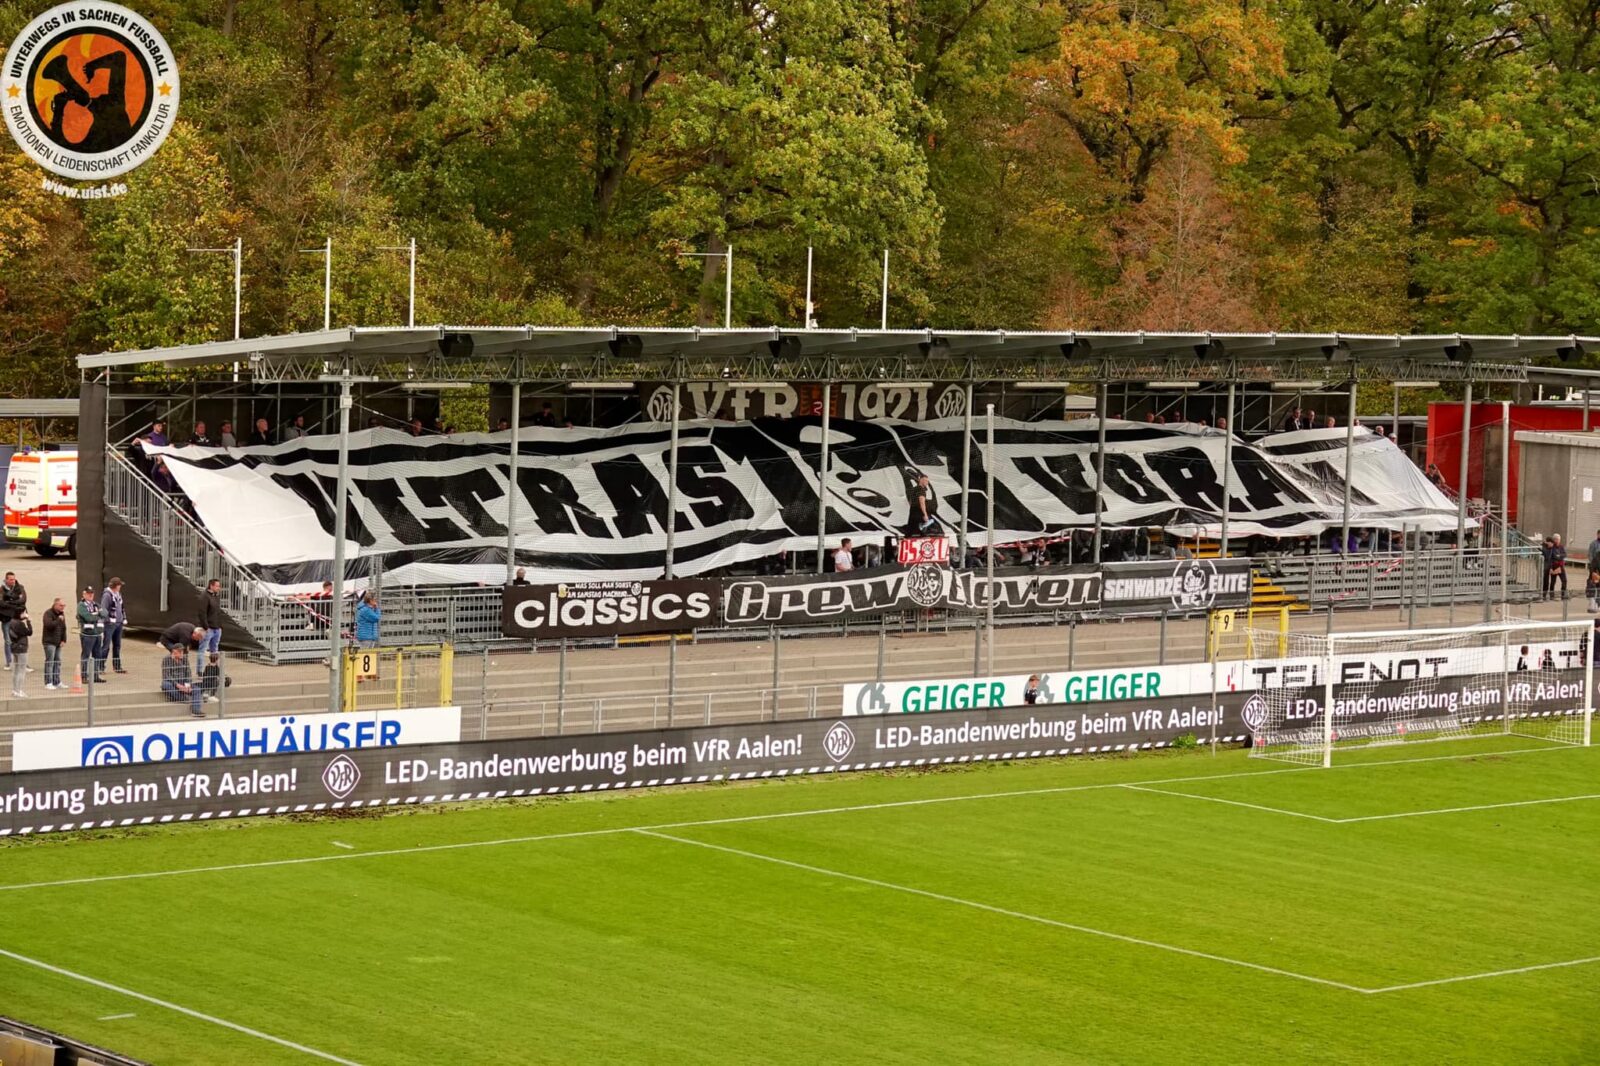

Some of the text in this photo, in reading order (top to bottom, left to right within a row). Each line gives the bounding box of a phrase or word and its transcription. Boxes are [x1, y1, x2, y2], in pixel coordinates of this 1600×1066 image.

[687, 382, 929, 422] VfR 1921
[724, 577, 904, 623] Crew
[1104, 573, 1248, 600] SCHWARZE ELITE
[514, 587, 711, 629] classics
[1223, 614, 1230, 630] 9
[363, 654, 370, 672] 8
[902, 682, 1005, 713] GEIGER
[1065, 672, 1161, 703] GEIGER
[1286, 689, 1458, 719] LED-andenwerbung
[1462, 687, 1500, 706] beim
[1535, 680, 1583, 701] Aalen!
[141, 717, 401, 761] OHNHÄUSER
[875, 705, 1224, 750] LED-Bandenwerbung beim VfR Aalen!
[385, 734, 803, 785] LED-Bandenwerbung beim VfR Aalen!
[93, 776, 158, 805] beim
[166, 772, 210, 799] VfR
[218, 768, 297, 796] Aalen!
